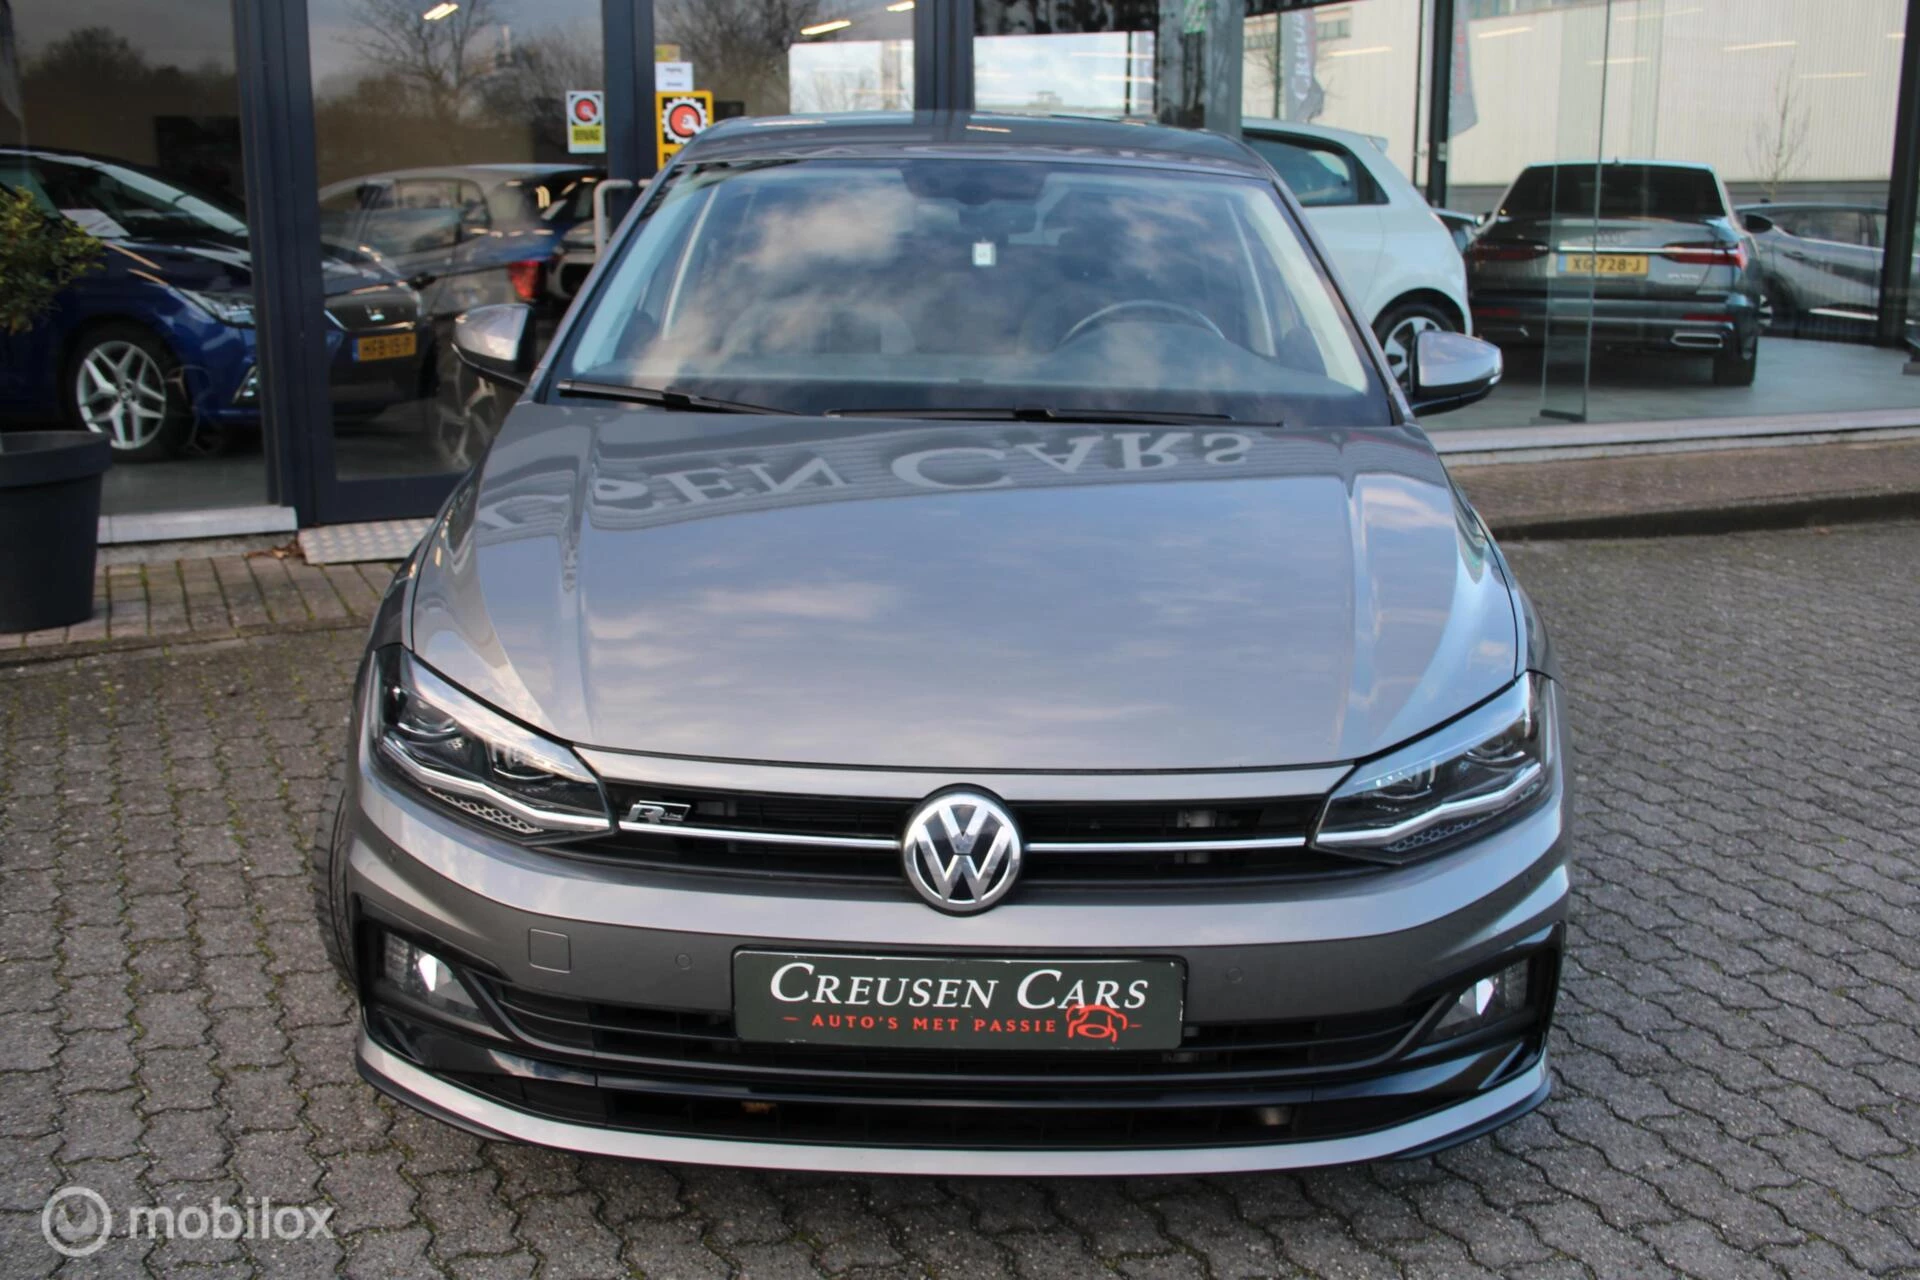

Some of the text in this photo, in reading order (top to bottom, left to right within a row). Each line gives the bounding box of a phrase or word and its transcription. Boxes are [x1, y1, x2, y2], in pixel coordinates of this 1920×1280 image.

[770, 962, 1149, 1010] CREUSEN CARS
[811, 1013, 1057, 1033] AUTO'S MET PASSIE
